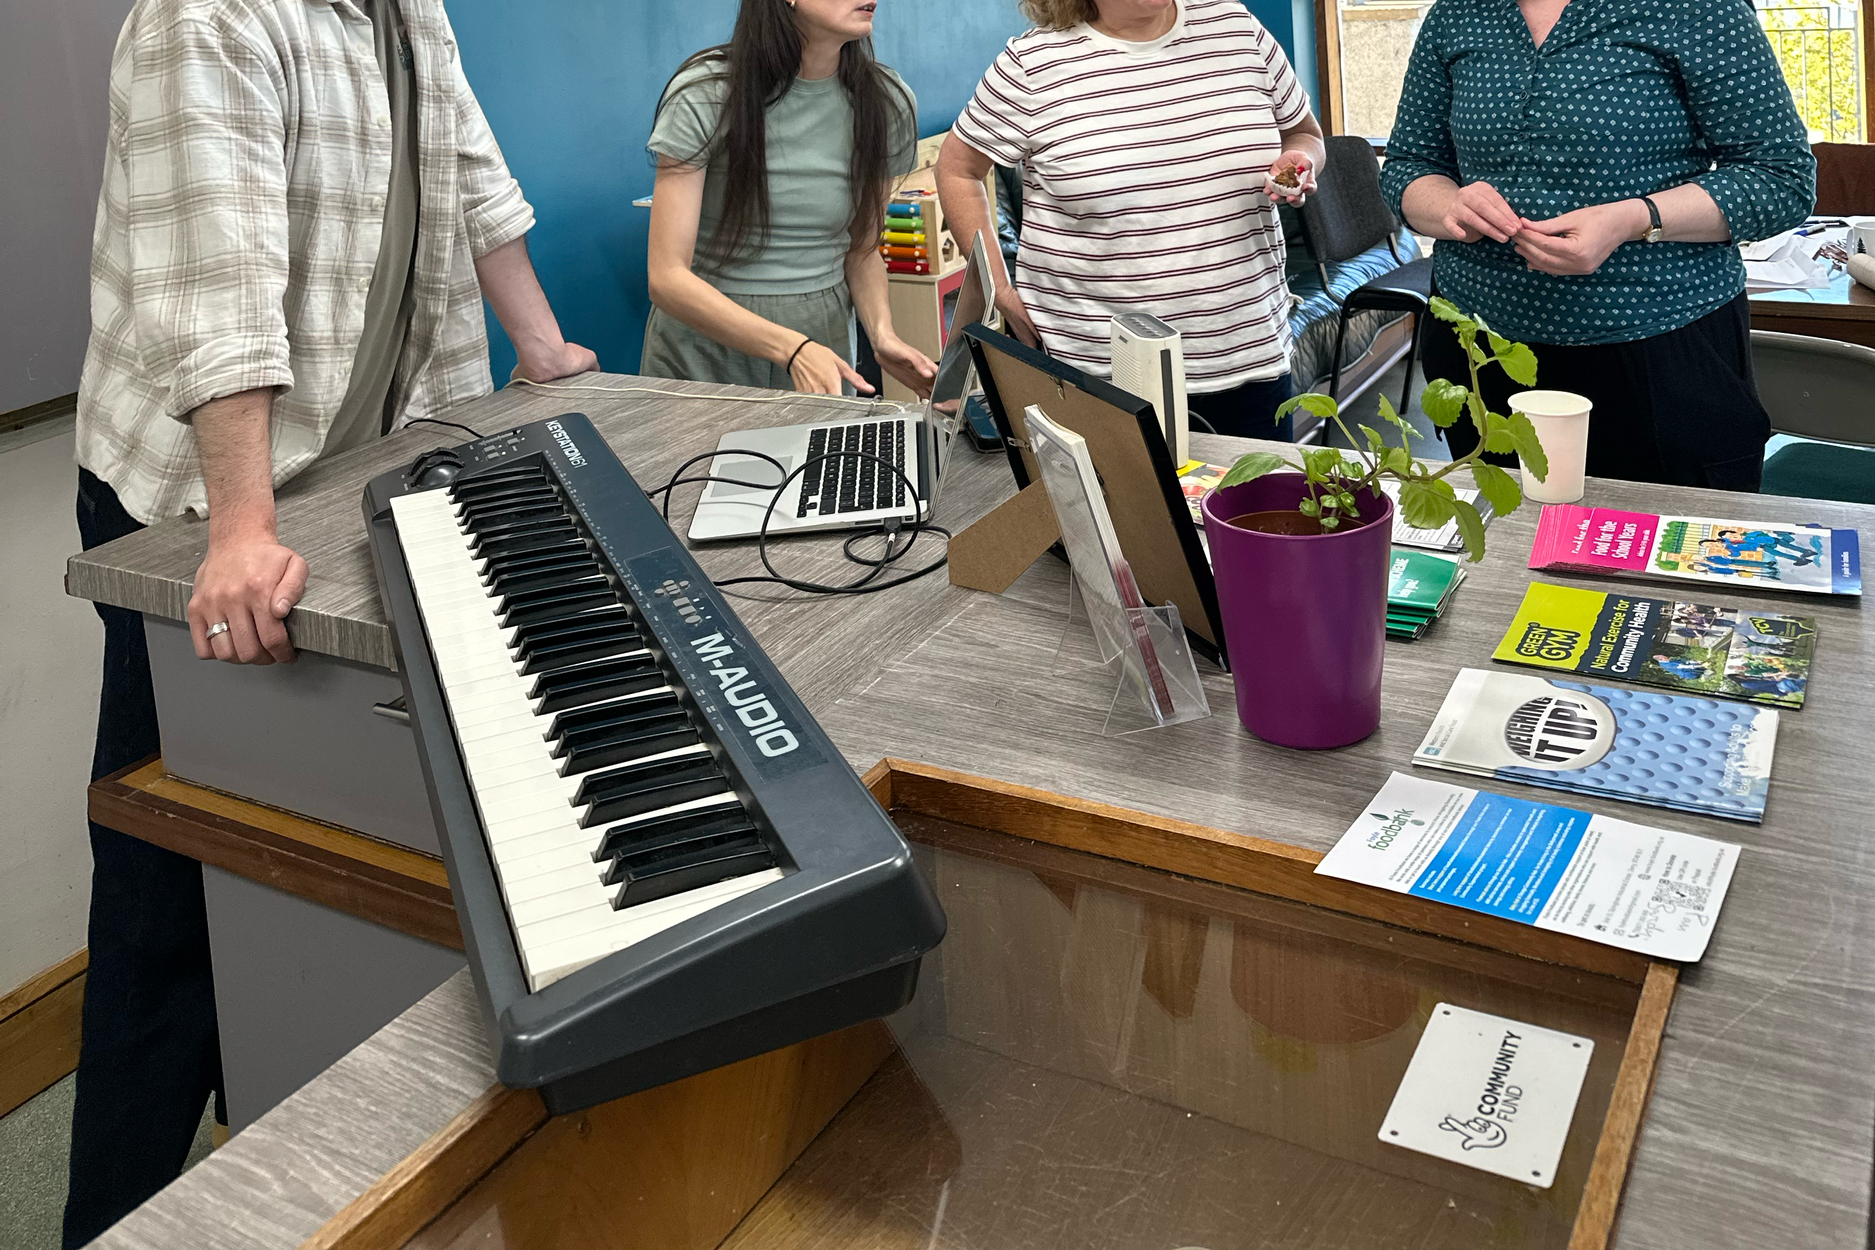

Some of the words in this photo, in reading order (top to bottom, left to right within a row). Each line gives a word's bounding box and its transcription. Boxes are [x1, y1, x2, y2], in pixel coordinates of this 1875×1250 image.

[1594, 532, 1613, 541] for
[1598, 520, 1617, 531] the
[1617, 522, 1637, 539] Years
[1590, 541, 1610, 555] Food
[1611, 539, 1632, 558] School
[1612, 599, 1629, 611] for
[1627, 602, 1650, 628] Health
[1601, 612, 1625, 642] Exercise
[1752, 618, 1773, 633] TCV
[1520, 627, 1547, 654] GREEN
[1539, 630, 1574, 660] GYM
[1611, 628, 1644, 672] Community
[1590, 642, 1614, 669] Natural
[690, 631, 800, 758] M-AUDIO
[1506, 697, 1552, 755] WEIGHING
[1542, 699, 1596, 739] UP!
[1533, 739, 1585, 762] IT
[1366, 831, 1380, 842] Foyle
[1367, 808, 1414, 850] foodbank
[1477, 1030, 1522, 1116] COMMUNITY
[1496, 1085, 1523, 1123] FUND
